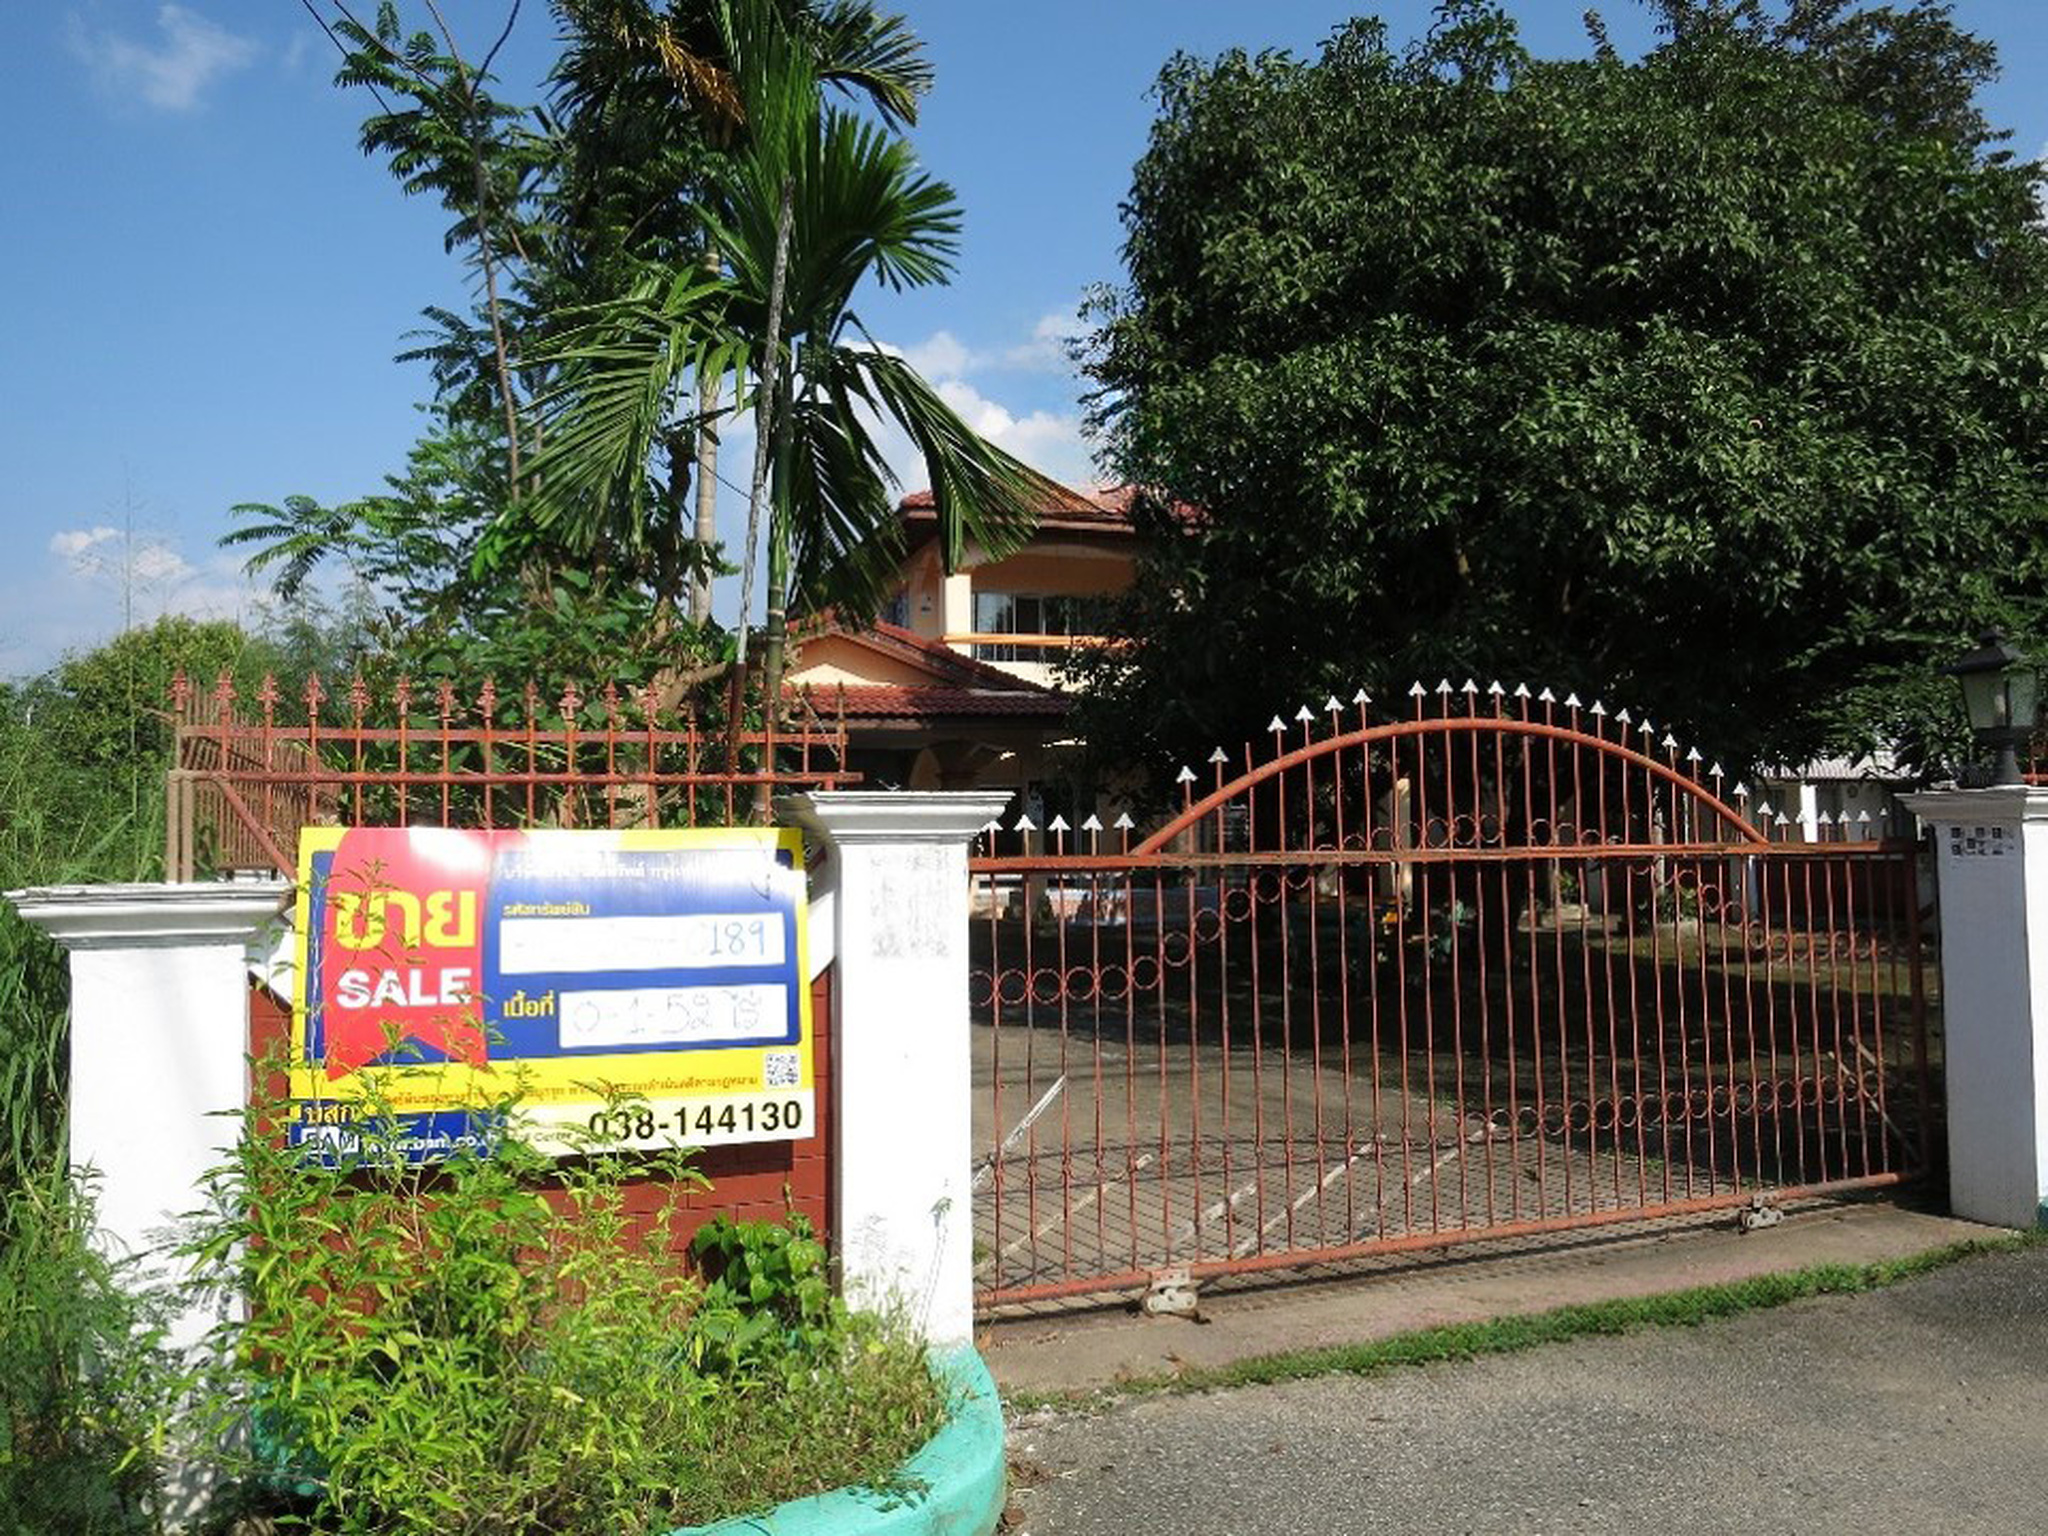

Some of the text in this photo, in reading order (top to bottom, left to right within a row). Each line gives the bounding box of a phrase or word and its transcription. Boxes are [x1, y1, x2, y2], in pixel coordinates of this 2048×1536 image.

[336, 890, 476, 950] ขาย
[336, 967, 473, 1009] SALE
[503, 989, 554, 1017] เนื้อที่
[588, 1099, 803, 1141] 038-144130
